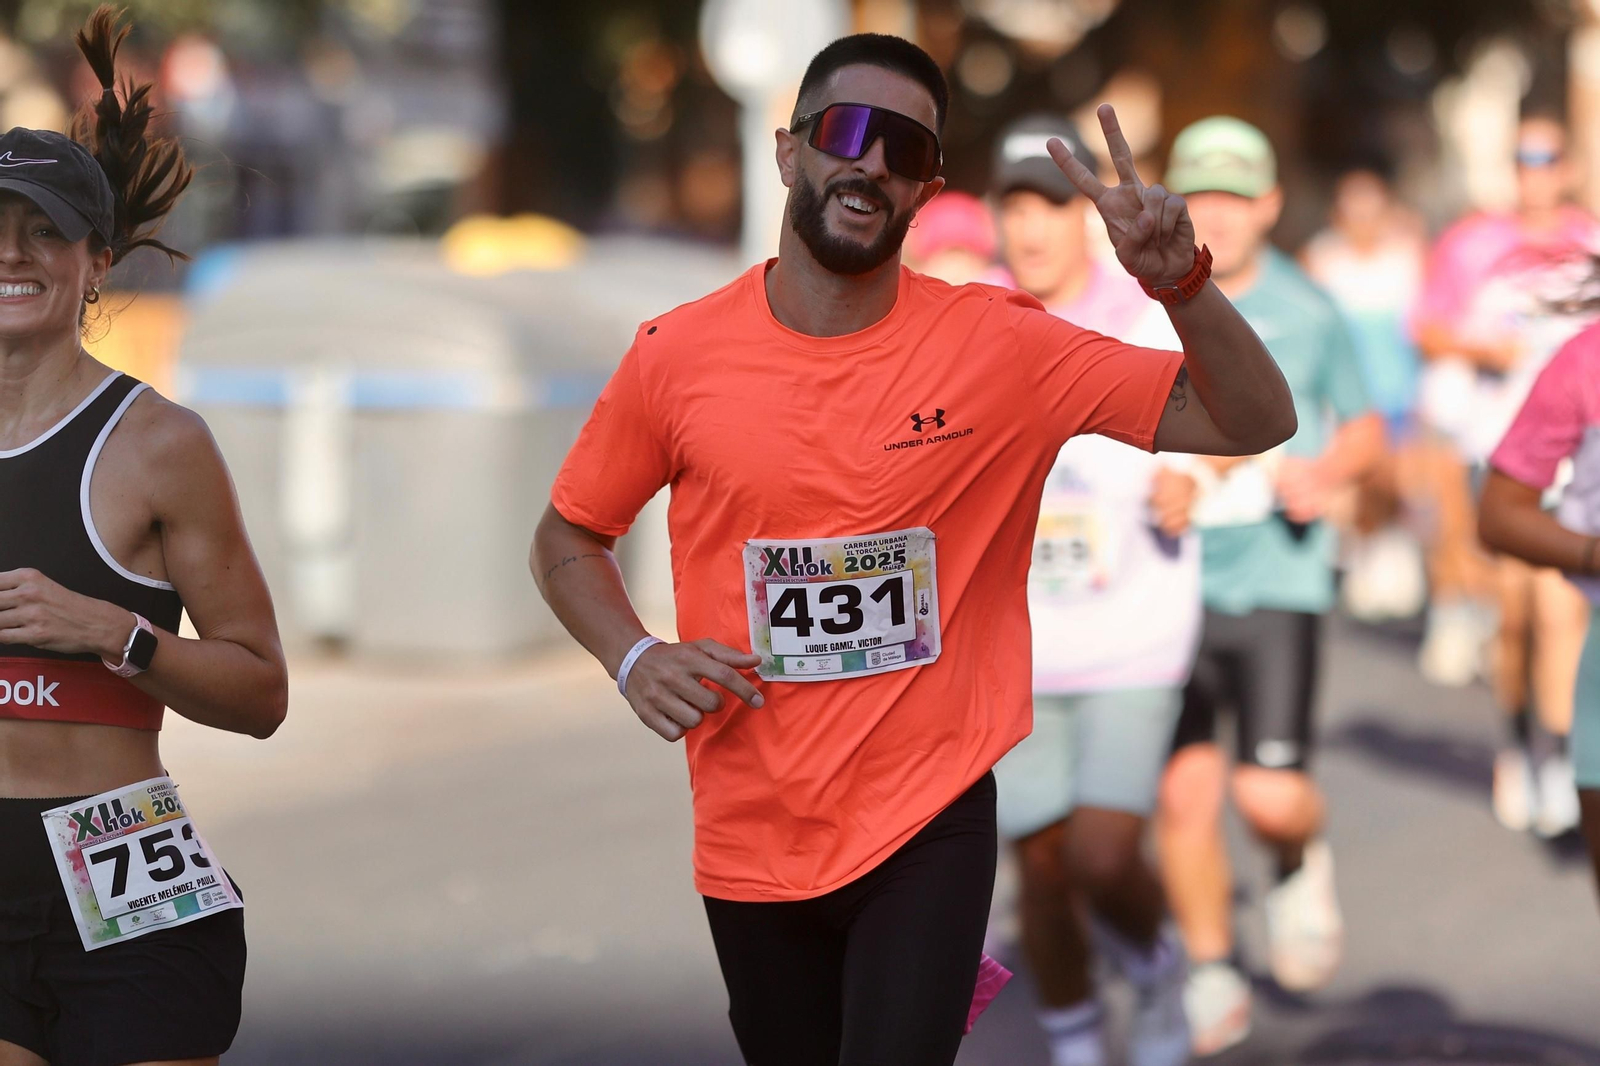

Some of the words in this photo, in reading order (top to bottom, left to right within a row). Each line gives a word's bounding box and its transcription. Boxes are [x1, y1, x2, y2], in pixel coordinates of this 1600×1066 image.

[884, 439, 923, 451] UNDER
[926, 428, 973, 444] ARMOUR
[844, 541, 877, 549] CARRERA
[879, 535, 908, 545] URBANA
[856, 547, 881, 555] TORCAL
[763, 547, 812, 576] XII
[844, 549, 906, 573] 2025
[770, 577, 905, 637] 431
[805, 643, 828, 653] LUQUE
[830, 640, 856, 652] GAMIZ,
[858, 637, 882, 648] VICTOR
[70, 798, 124, 842] XII
[128, 894, 157, 909] VICENTE
[197, 874, 216, 887] PAULA
